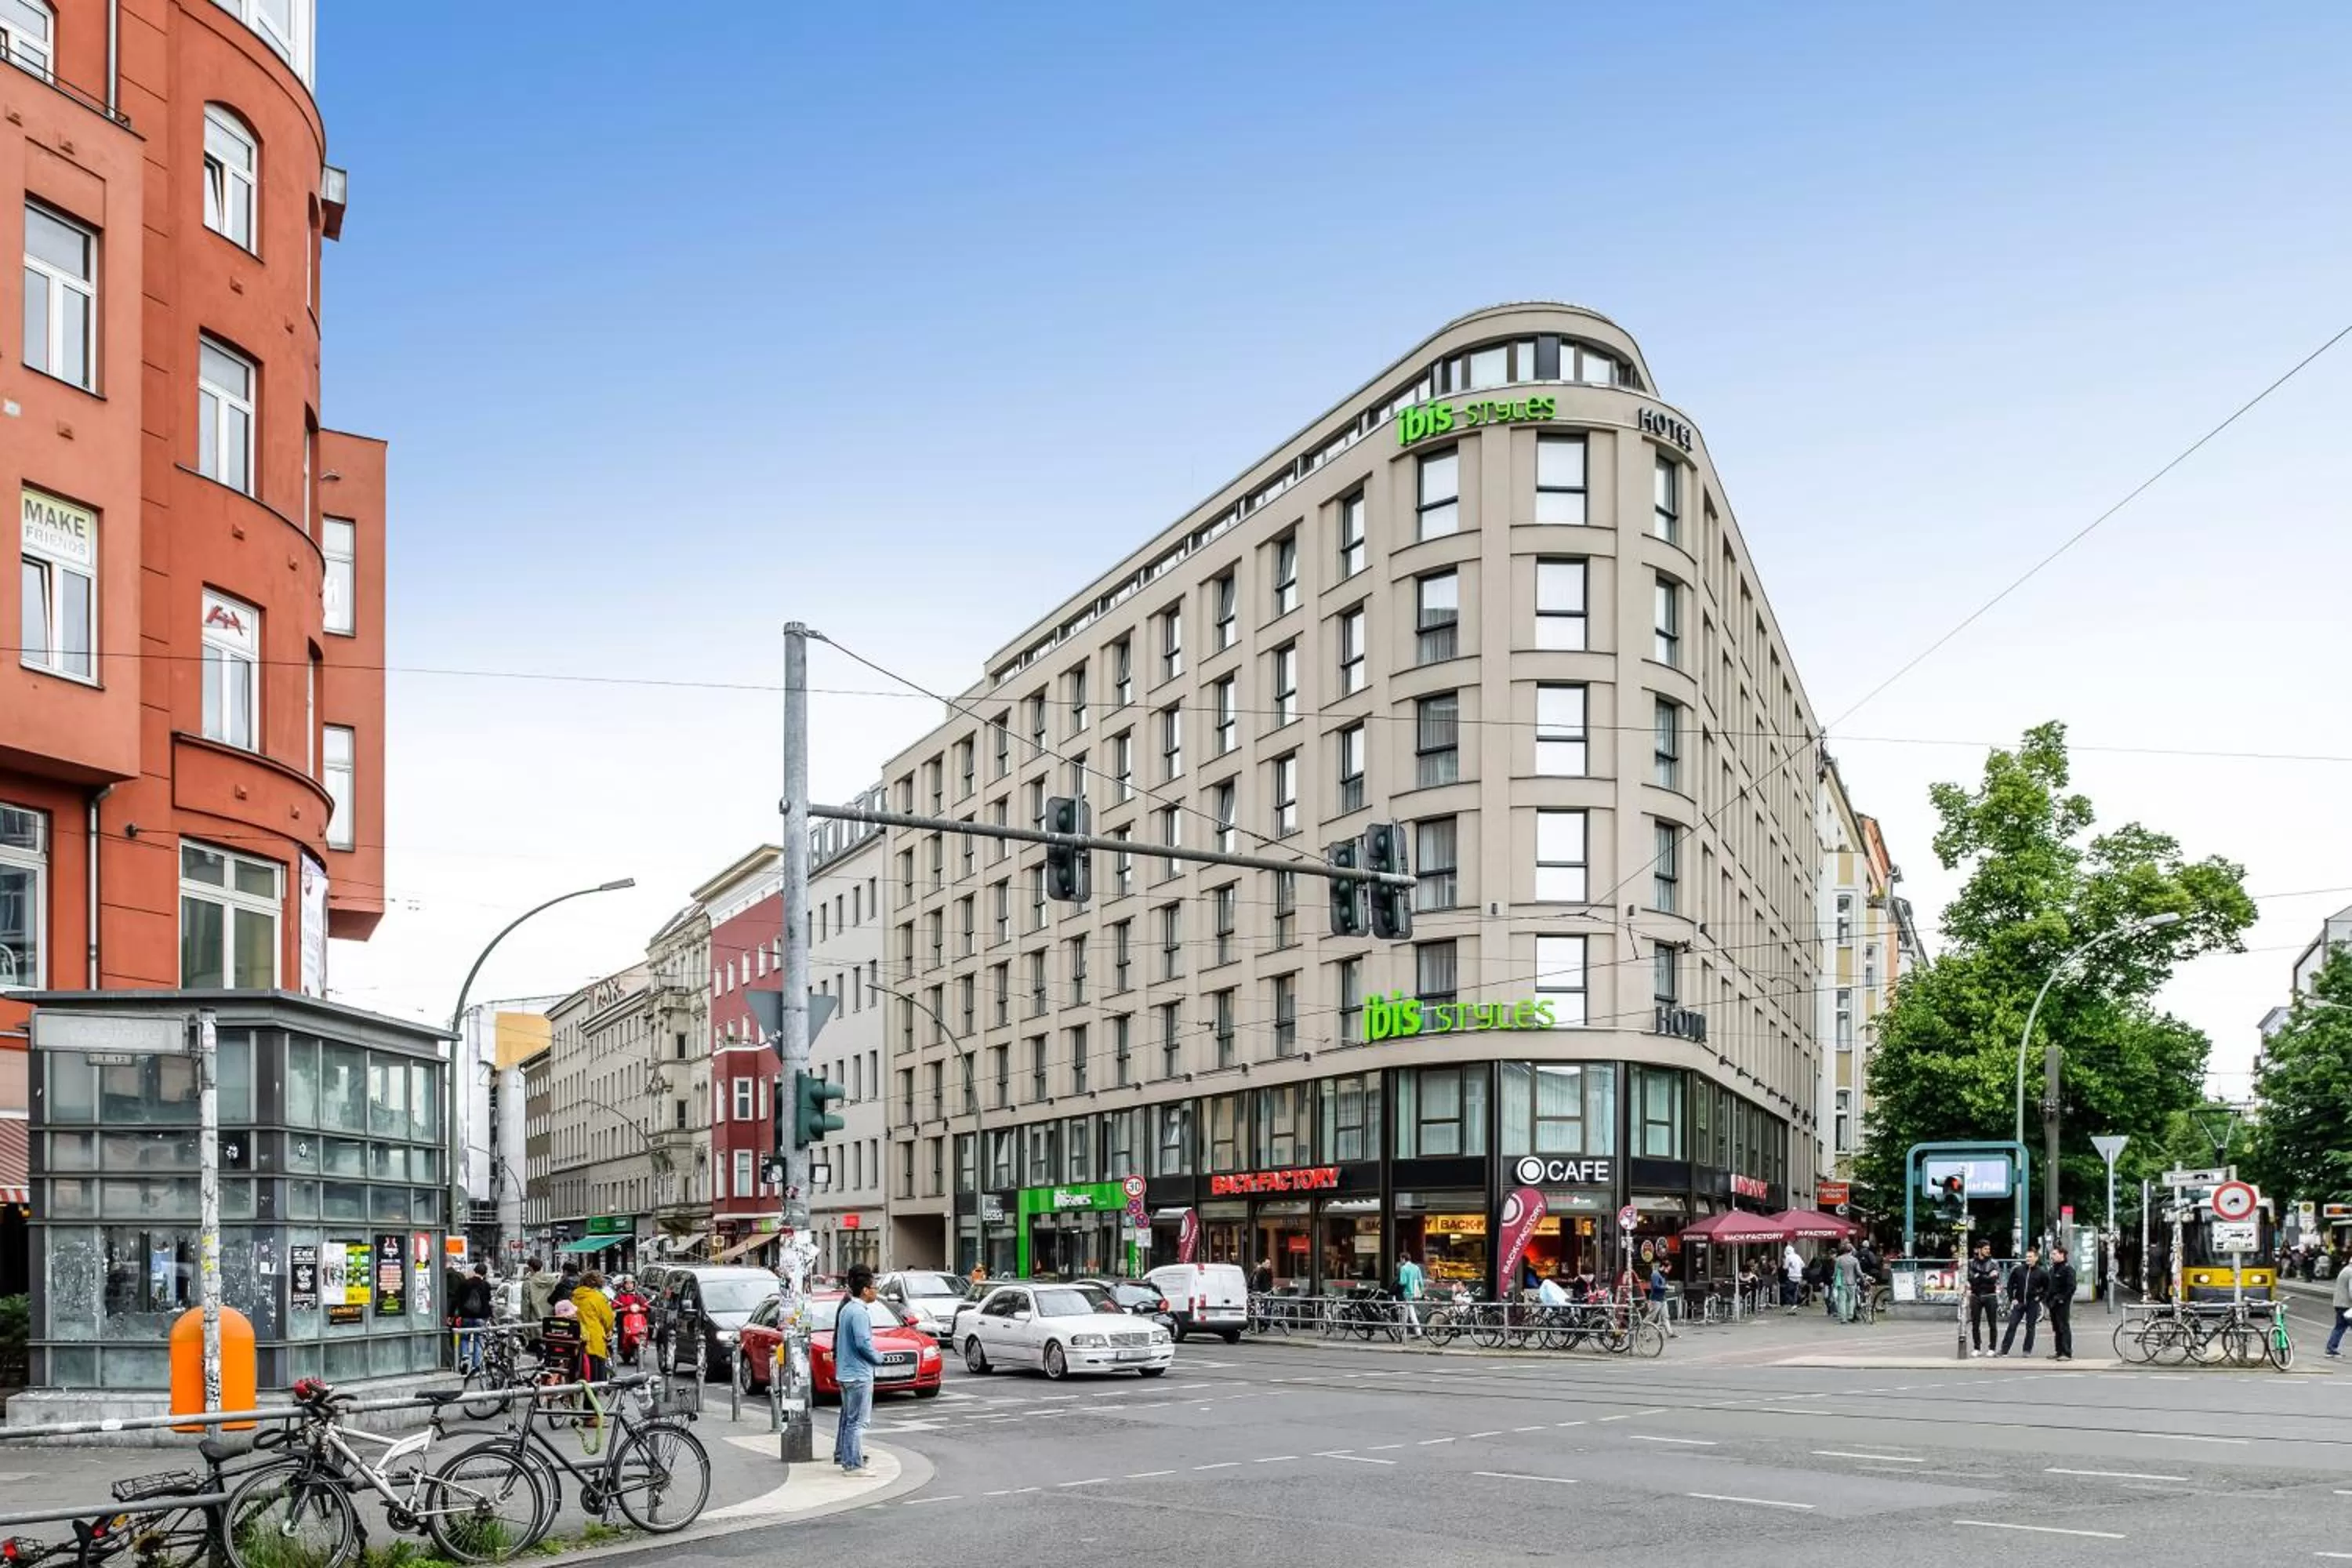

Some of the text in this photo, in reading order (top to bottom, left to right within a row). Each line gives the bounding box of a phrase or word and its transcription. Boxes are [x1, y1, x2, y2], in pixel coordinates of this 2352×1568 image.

[1398, 398, 1454, 446] ibis
[24, 498, 85, 539] MAKE
[25, 524, 86, 556] FRIENDS
[1363, 989, 1424, 1044] ibis
[1127, 1181, 1141, 1192] 30
[1547, 1160, 1610, 1182] CAFE
